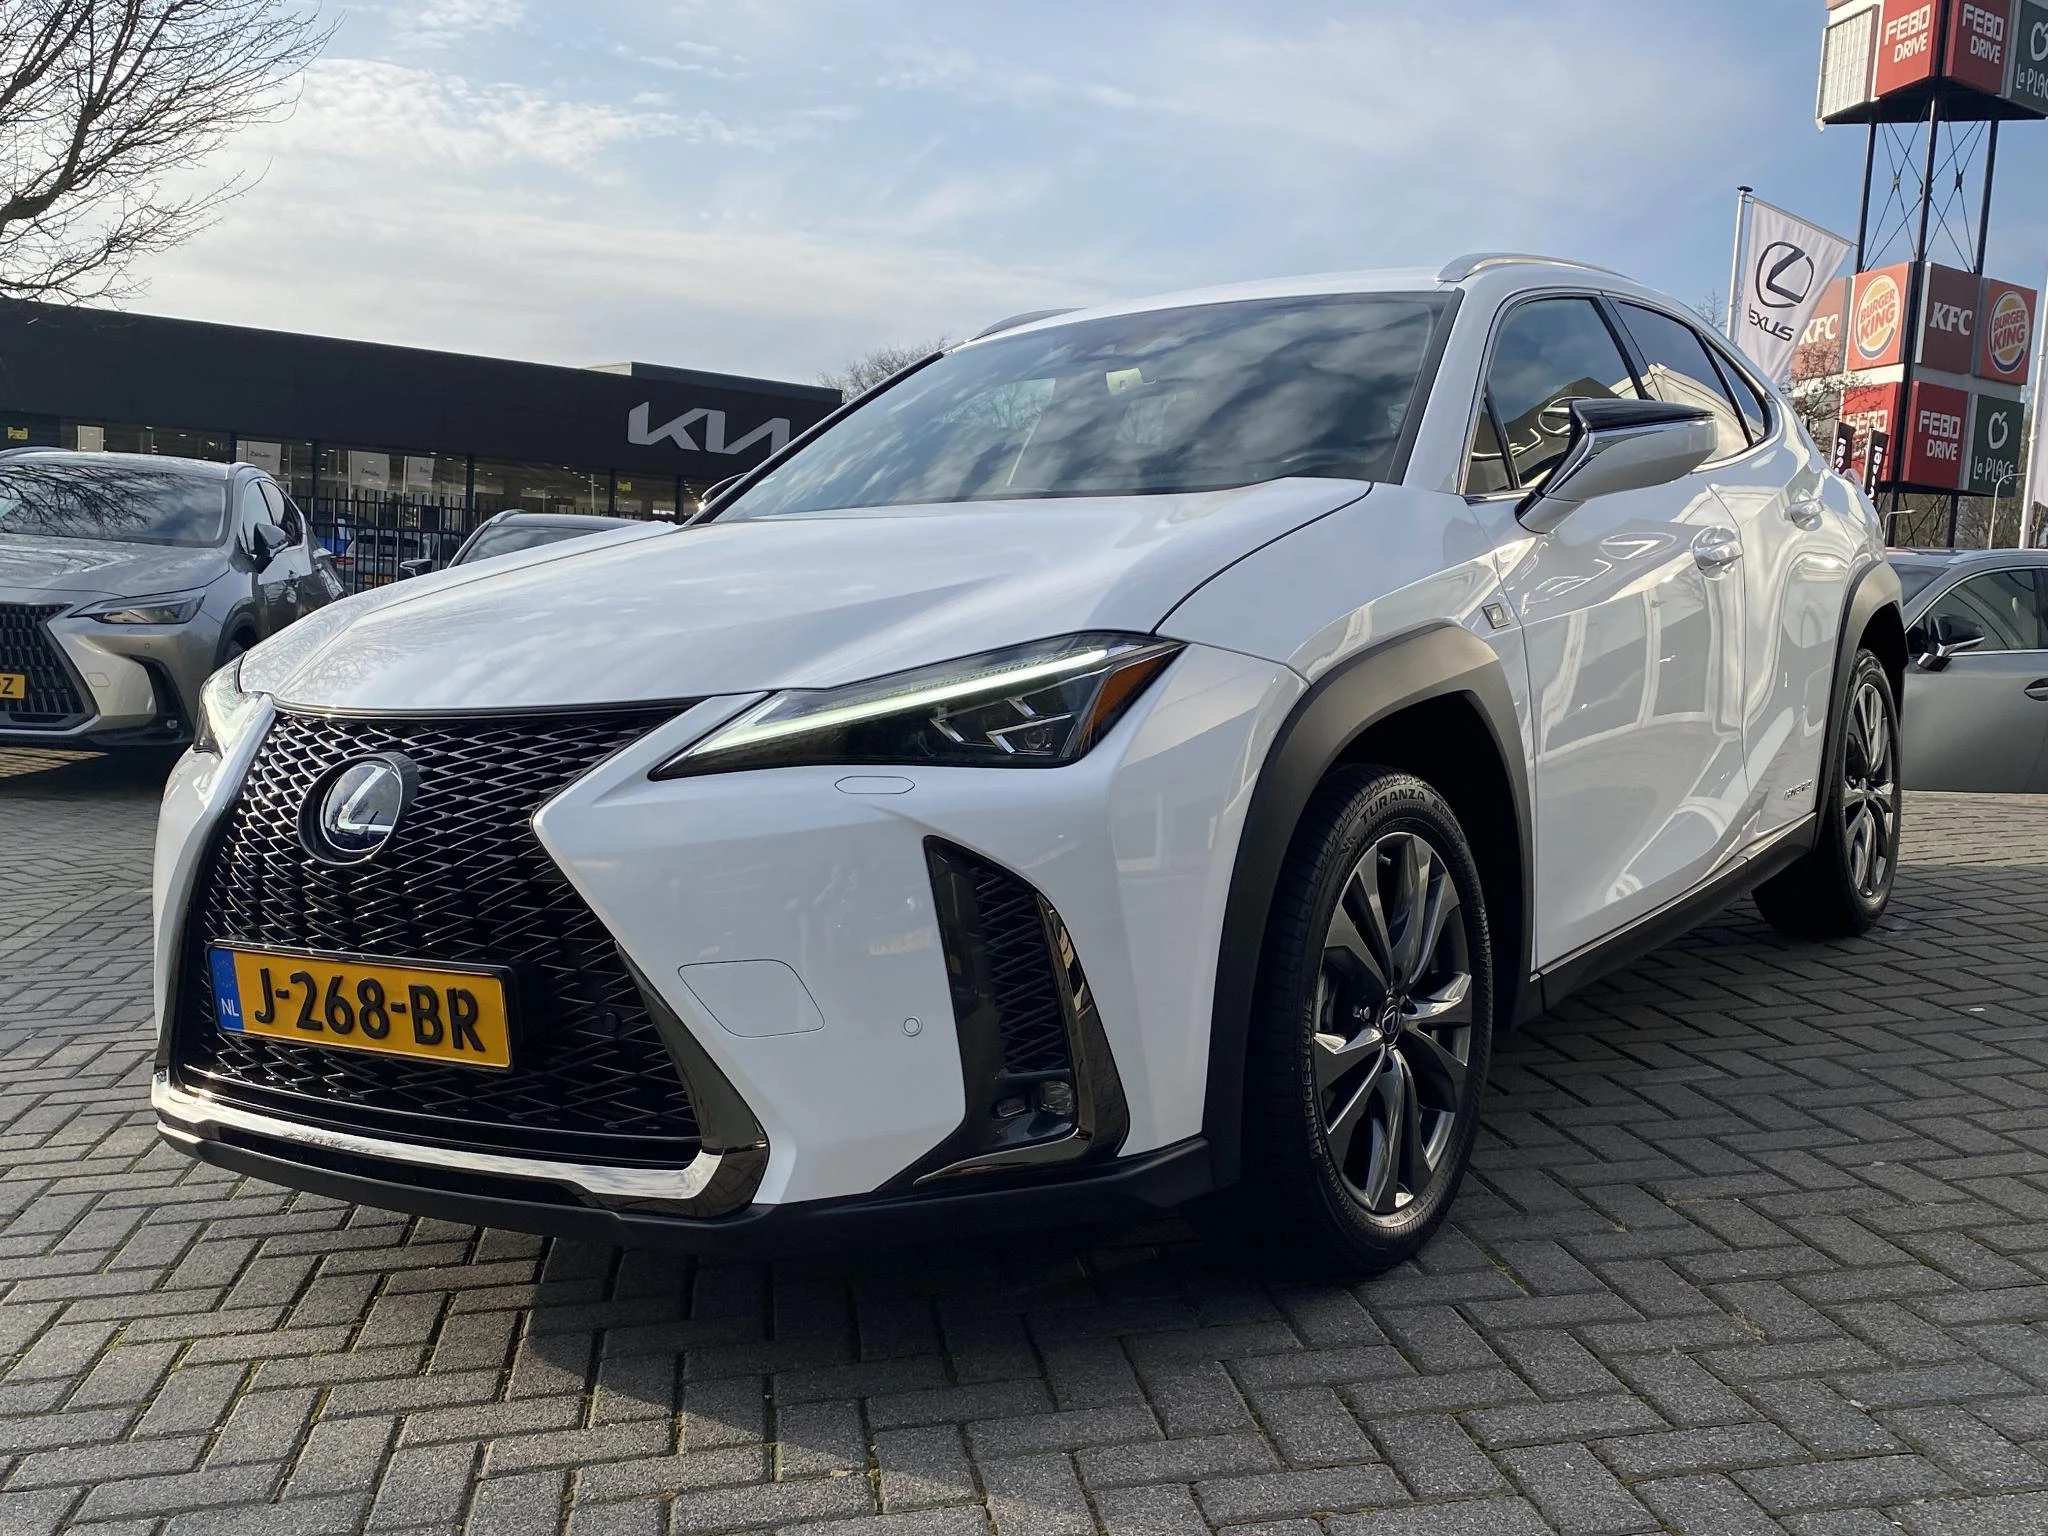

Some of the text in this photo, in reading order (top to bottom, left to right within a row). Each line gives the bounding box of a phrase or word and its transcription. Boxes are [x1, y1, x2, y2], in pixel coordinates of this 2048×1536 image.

[1884, 3, 1931, 46] FEBO
[1962, 3, 2004, 42] FEBO
[1893, 32, 1928, 63] DRIVE
[1970, 35, 2001, 64] DRIVE
[1860, 288, 1896, 323] BURGER
[1929, 302, 1973, 336] KFC
[1993, 309, 2026, 332] BURGER
[1798, 313, 1839, 346] KFC
[1860, 303, 1896, 342] KING
[1993, 324, 2026, 353] KING
[1918, 409, 1961, 440] FEBO
[1926, 438, 1958, 461] DRIVE
[1984, 457, 2015, 485] PLACE
[0, 677, 14, 694] Z
[1360, 788, 1426, 825] TURANZA
[221, 997, 240, 1018] NL
[254, 967, 486, 1052] J-268-BR
